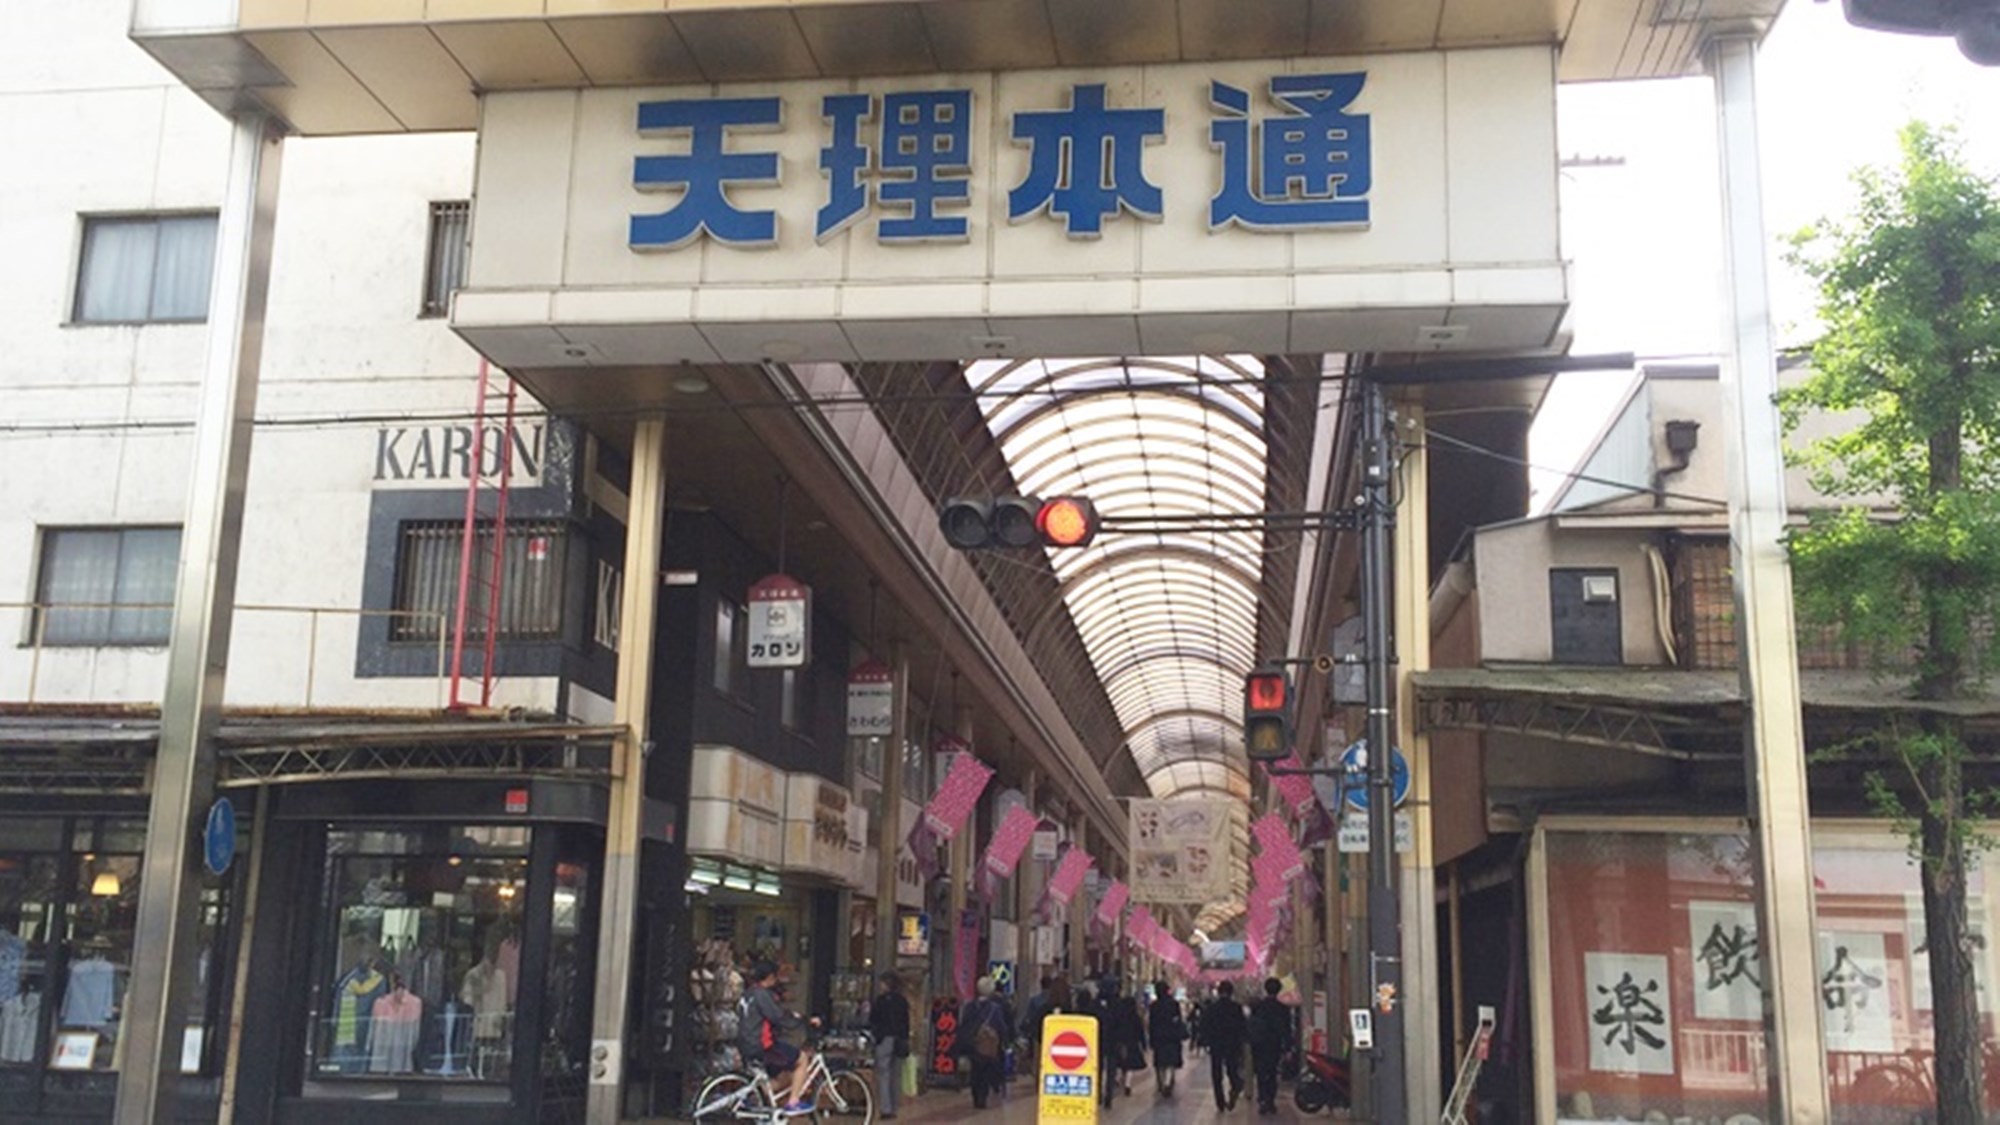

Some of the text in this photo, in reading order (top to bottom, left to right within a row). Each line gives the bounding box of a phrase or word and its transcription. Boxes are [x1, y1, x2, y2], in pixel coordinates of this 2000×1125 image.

[629, 71, 1373, 251] 天理本通
[373, 425, 541, 480] KARON
[751, 643, 800, 658] カロン
[1697, 922, 1760, 991] 飲
[1823, 945, 1883, 1033] 命
[935, 1010, 957, 1075] めがね
[1593, 971, 1666, 1056] 楽
